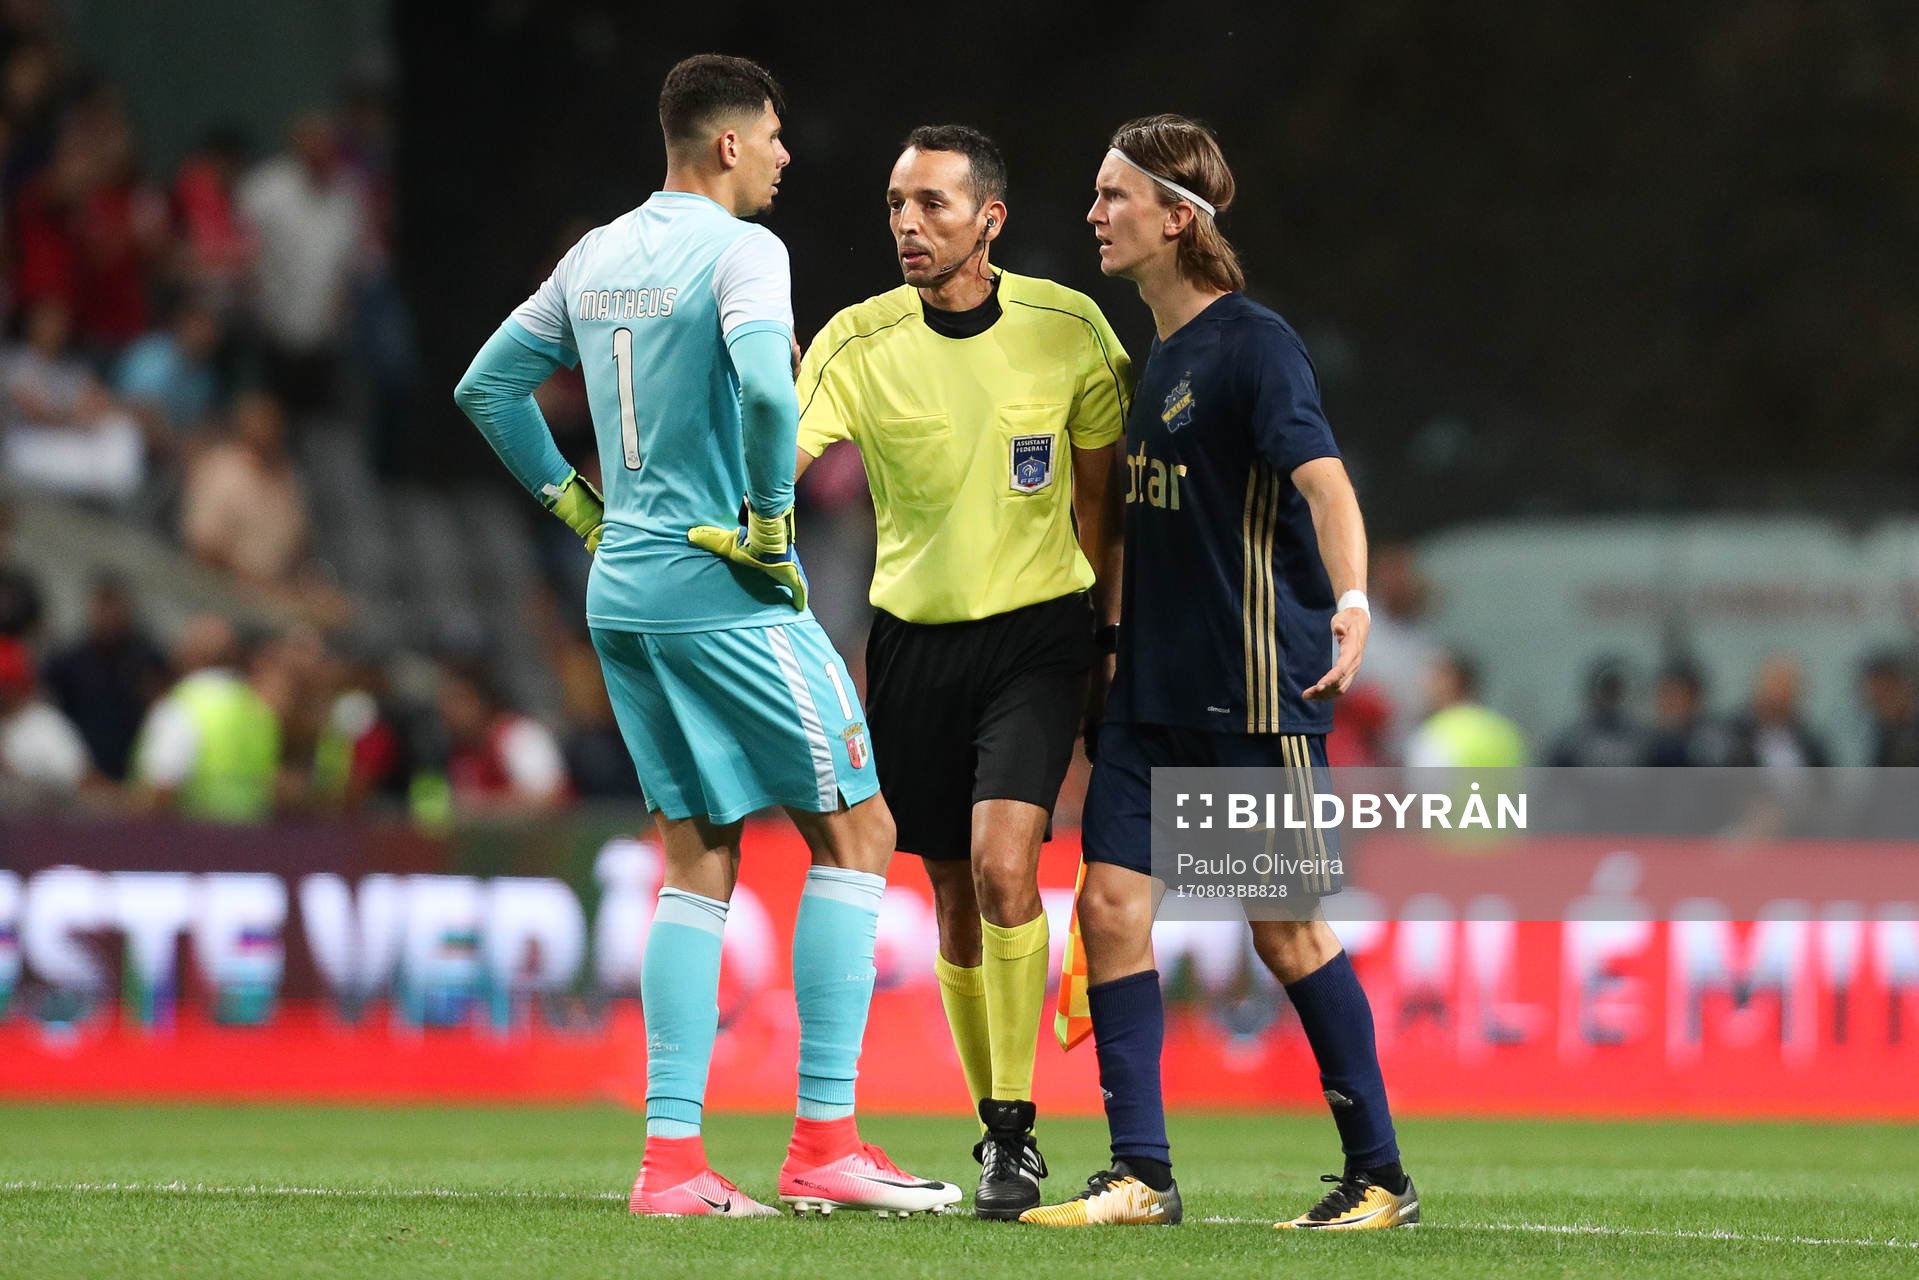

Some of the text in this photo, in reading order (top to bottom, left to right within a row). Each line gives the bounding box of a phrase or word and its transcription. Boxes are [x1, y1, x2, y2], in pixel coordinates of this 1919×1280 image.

[579, 287, 677, 320] MATHEUS
[612, 327, 642, 471] 1
[1016, 439, 1049, 447] ASSISTANT
[1016, 445, 1043, 453] FEDERAL
[824, 661, 853, 720] 1
[0, 866, 288, 1035] STE
